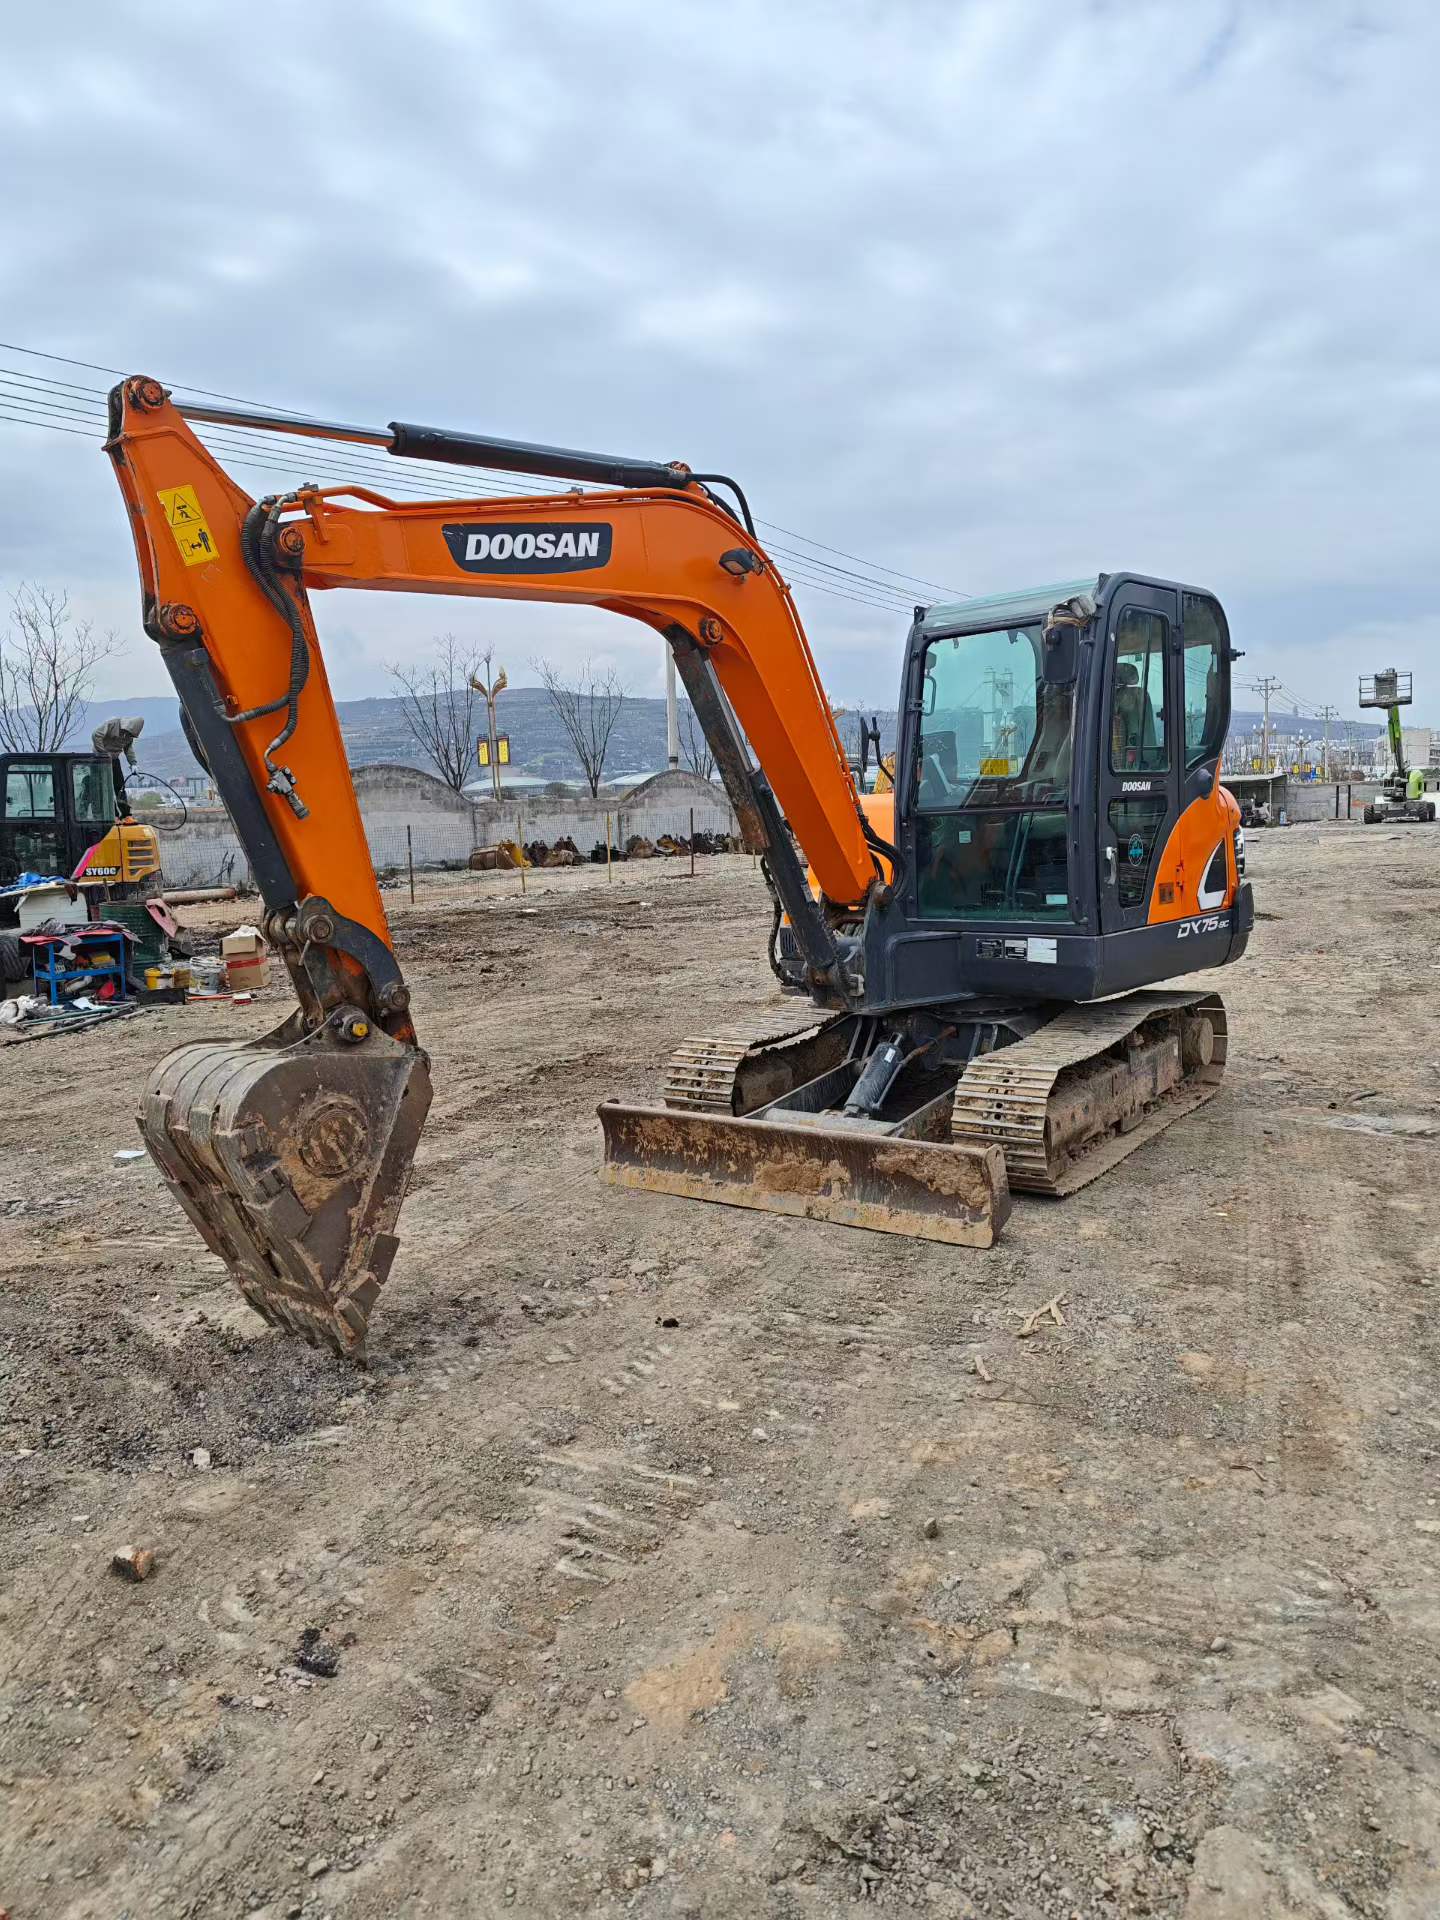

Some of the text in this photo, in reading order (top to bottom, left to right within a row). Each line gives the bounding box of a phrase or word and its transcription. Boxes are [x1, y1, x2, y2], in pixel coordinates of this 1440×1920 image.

[465, 532, 600, 561] DOOSAN
[1121, 781, 1152, 792] DOOSAN
[85, 867, 117, 876] SY60C
